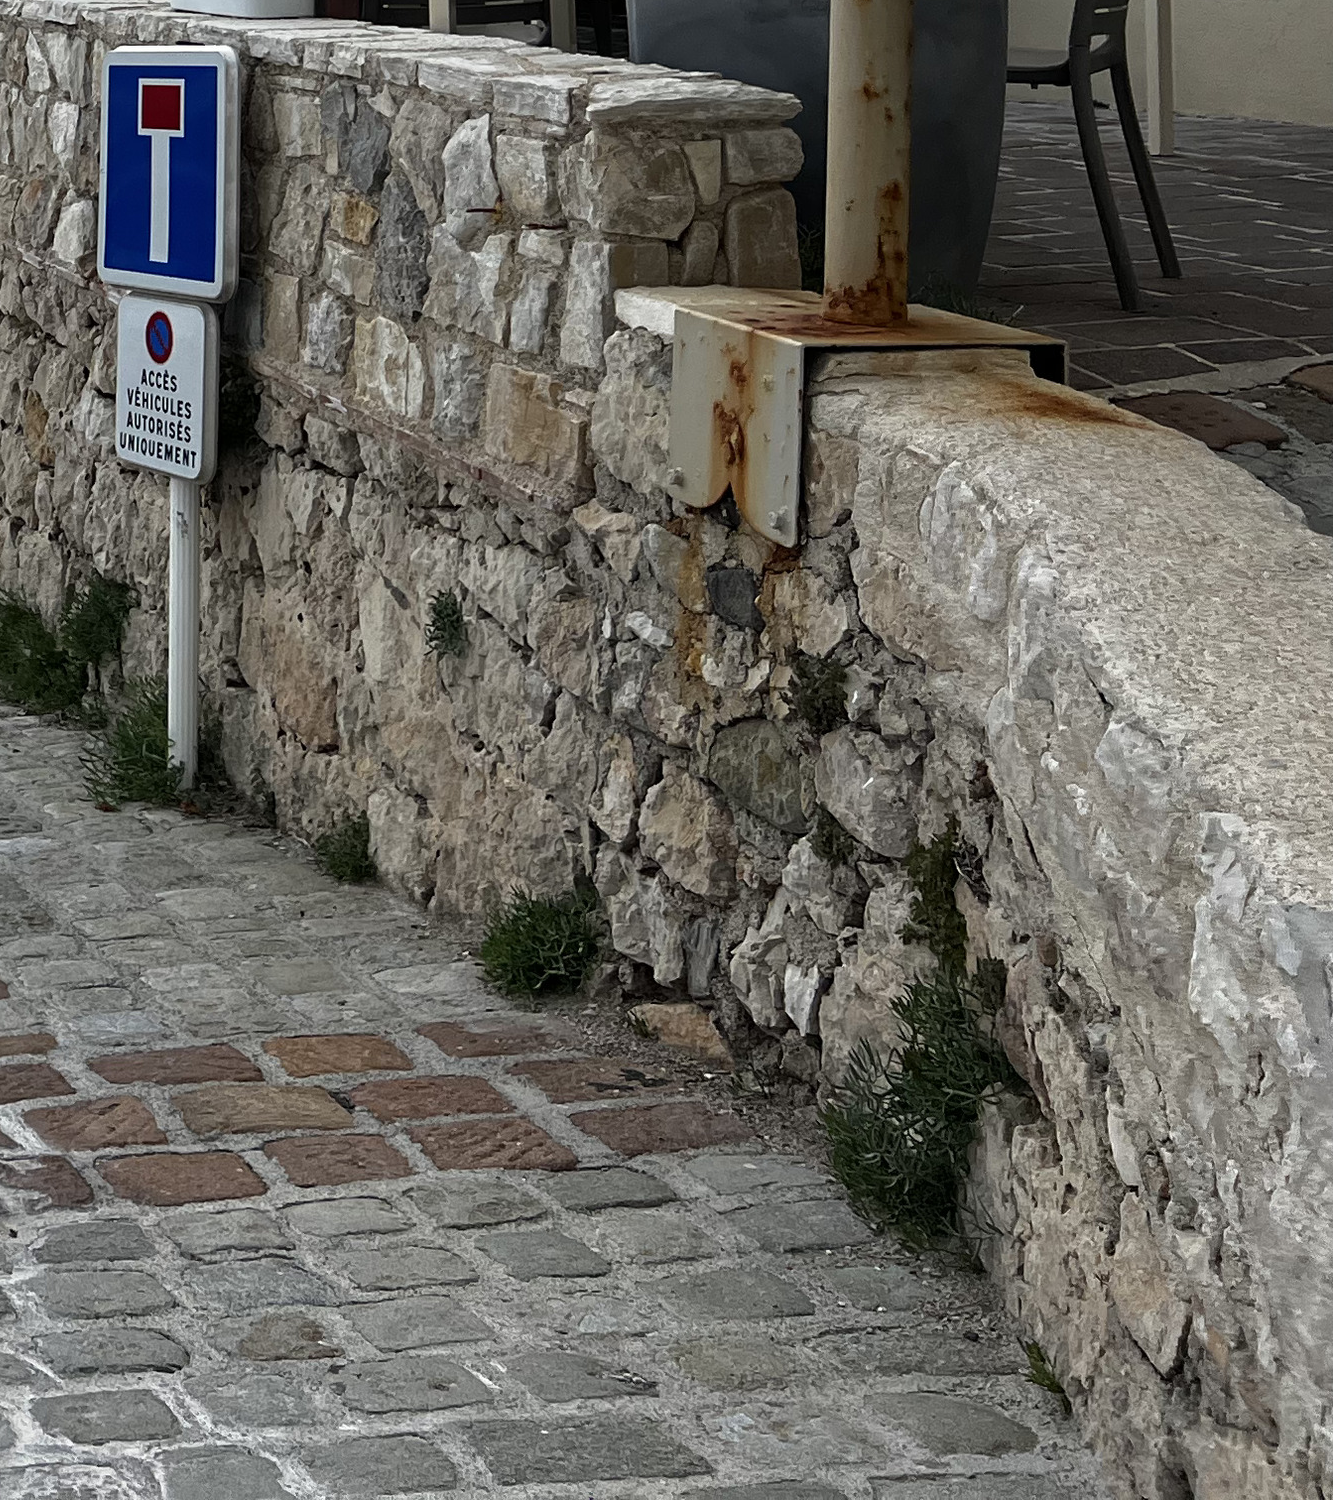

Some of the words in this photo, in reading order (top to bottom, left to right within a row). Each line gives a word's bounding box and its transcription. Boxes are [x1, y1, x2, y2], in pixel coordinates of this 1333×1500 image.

[141, 368, 178, 392] ACCÈS
[127, 386, 192, 419] VÉHICULES
[126, 411, 192, 443] AUTORISÉS
[119, 432, 197, 468] UNIQUEMENT
